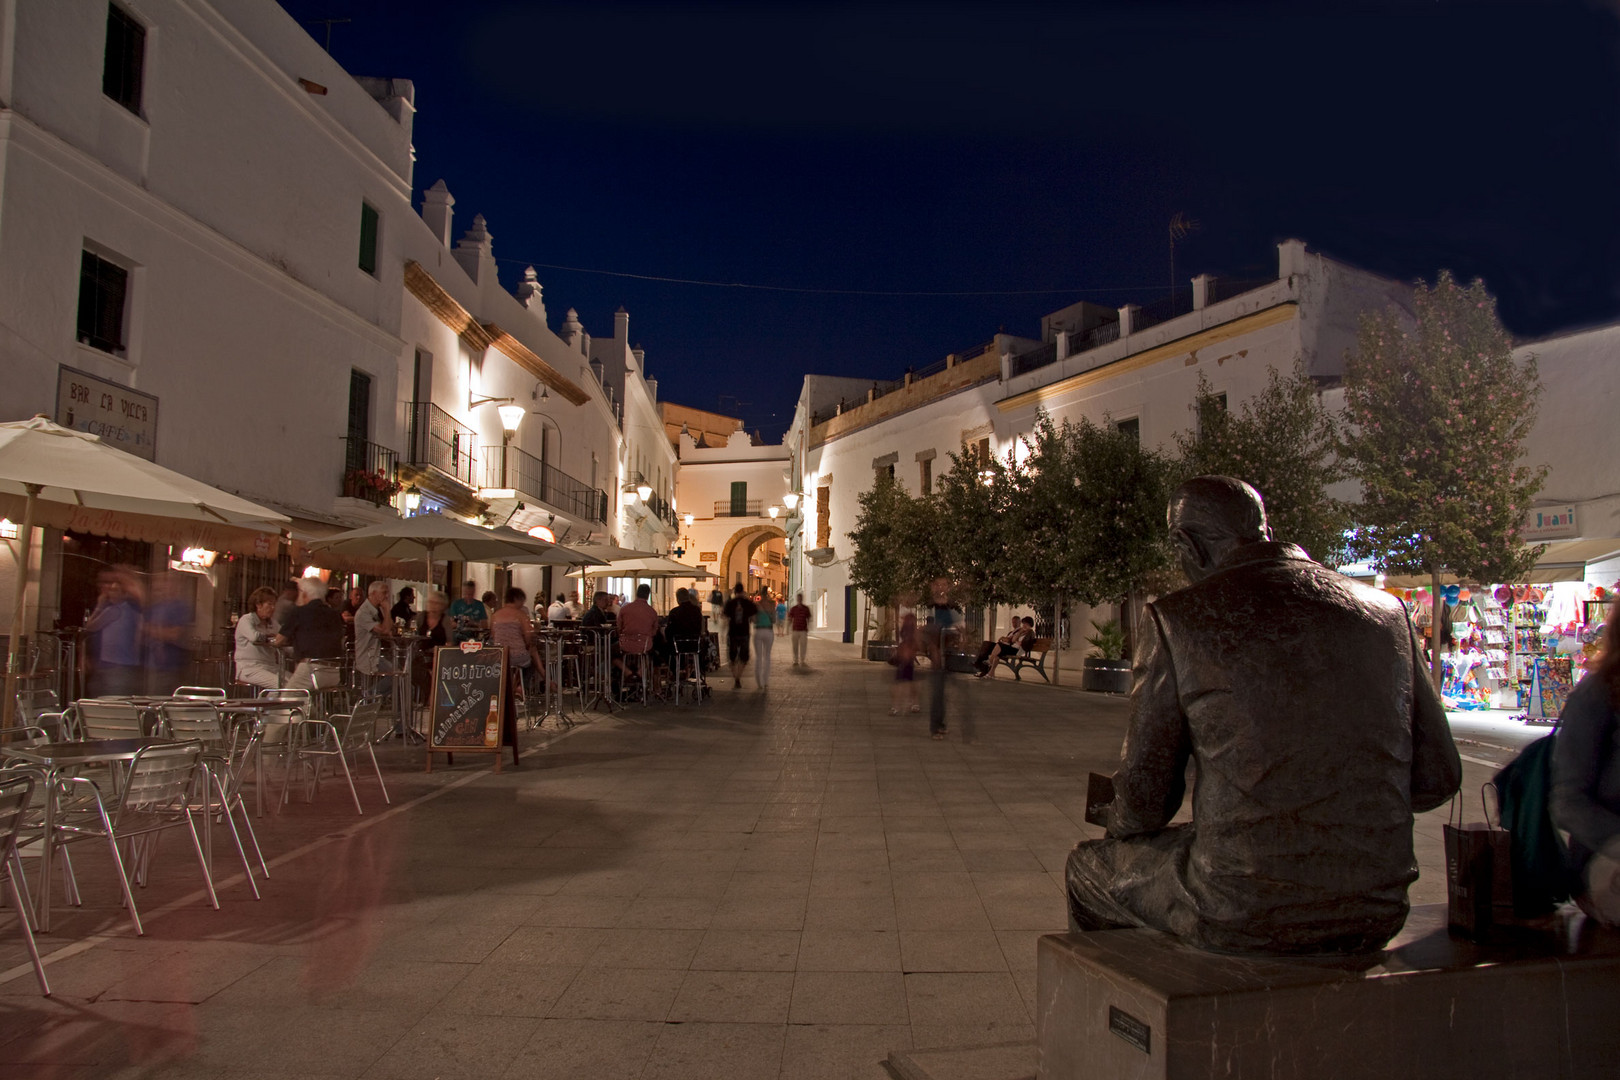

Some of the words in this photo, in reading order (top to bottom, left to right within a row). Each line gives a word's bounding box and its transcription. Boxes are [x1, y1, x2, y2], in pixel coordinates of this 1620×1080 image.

[70, 382, 90, 404] BAR
[100, 393, 113, 414] LA
[120, 398, 148, 423] VILLA
[87, 419, 125, 442] CAFÉ
[1536, 508, 1574, 528] Juani
[461, 682, 472, 694] Y
